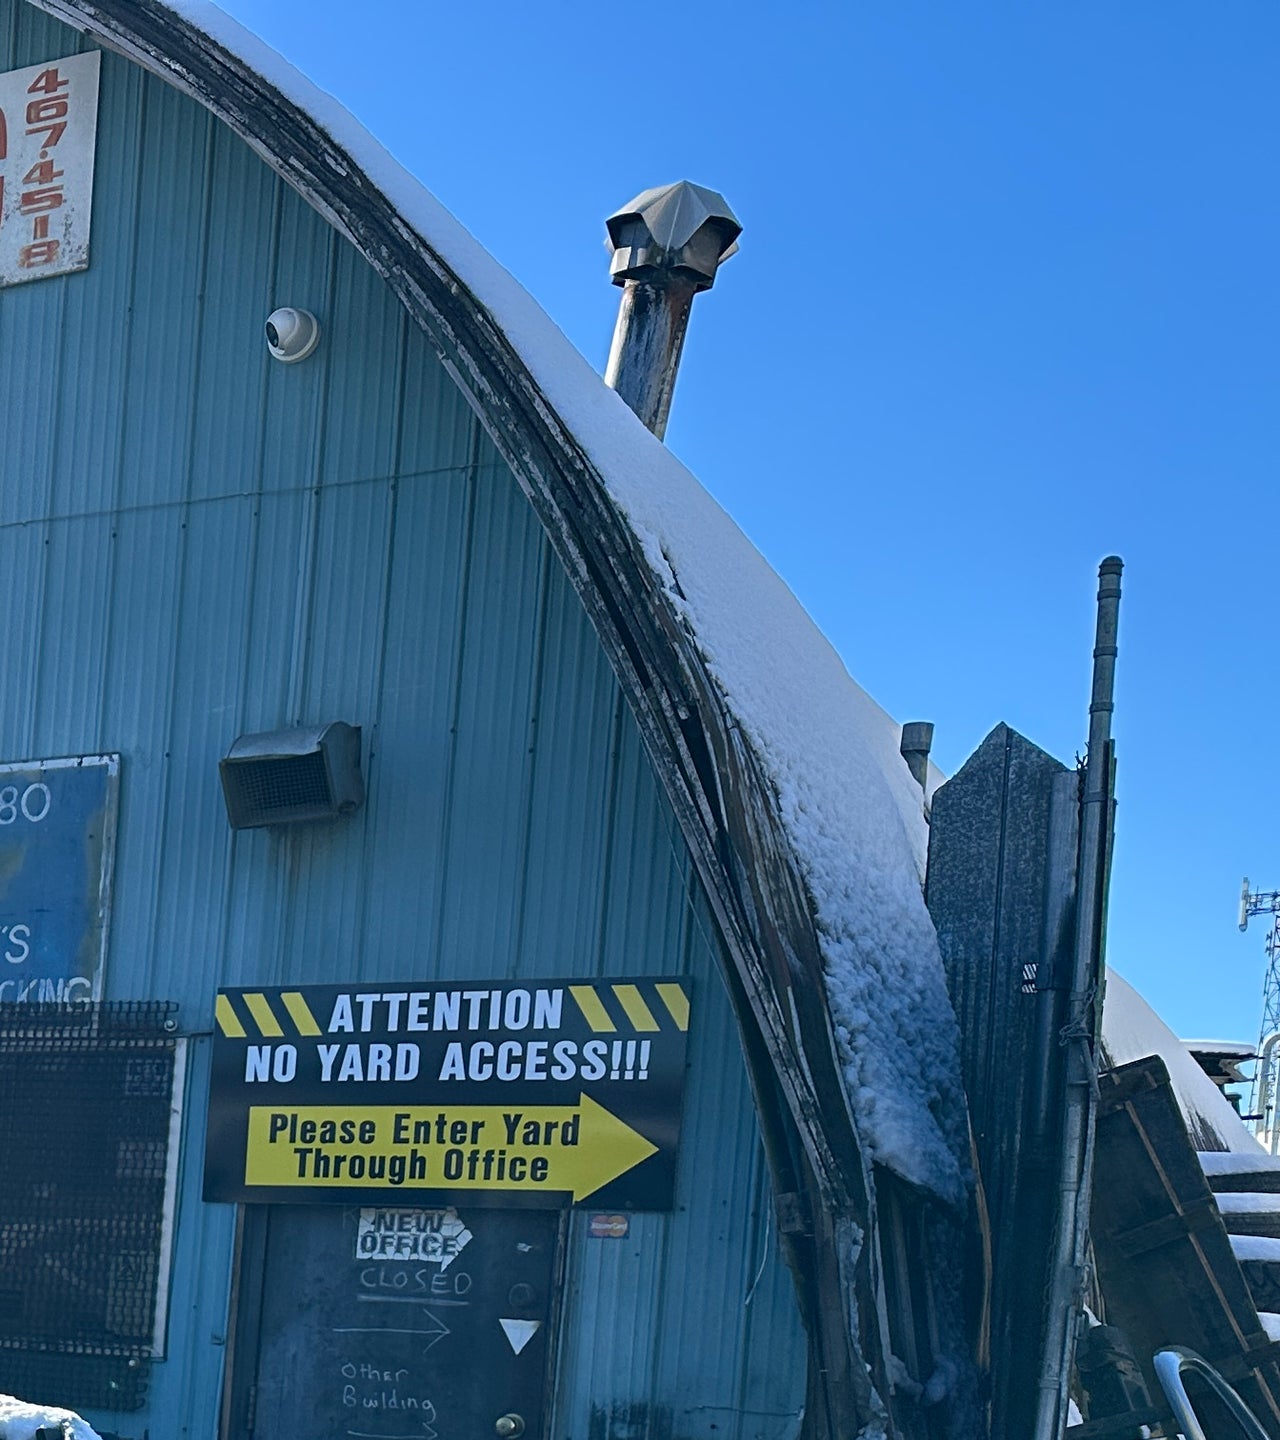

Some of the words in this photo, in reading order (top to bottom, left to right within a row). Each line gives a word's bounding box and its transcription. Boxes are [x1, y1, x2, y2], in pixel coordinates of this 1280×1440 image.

[328, 988, 564, 1032] ATTENTION
[245, 1045, 297, 1083] NO
[317, 1043, 420, 1082] YARD
[438, 1040, 652, 1081] ACCESS!!!
[268, 1113, 376, 1145] Please
[393, 1114, 485, 1146] Enter
[502, 1113, 580, 1147] Yard
[293, 1147, 427, 1185] Through
[443, 1149, 549, 1182] Office
[376, 1212, 444, 1232] NEW
[360, 1232, 459, 1255] OFFICE
[359, 1267, 473, 1295] CLOSED
[342, 1384, 437, 1424] Building
